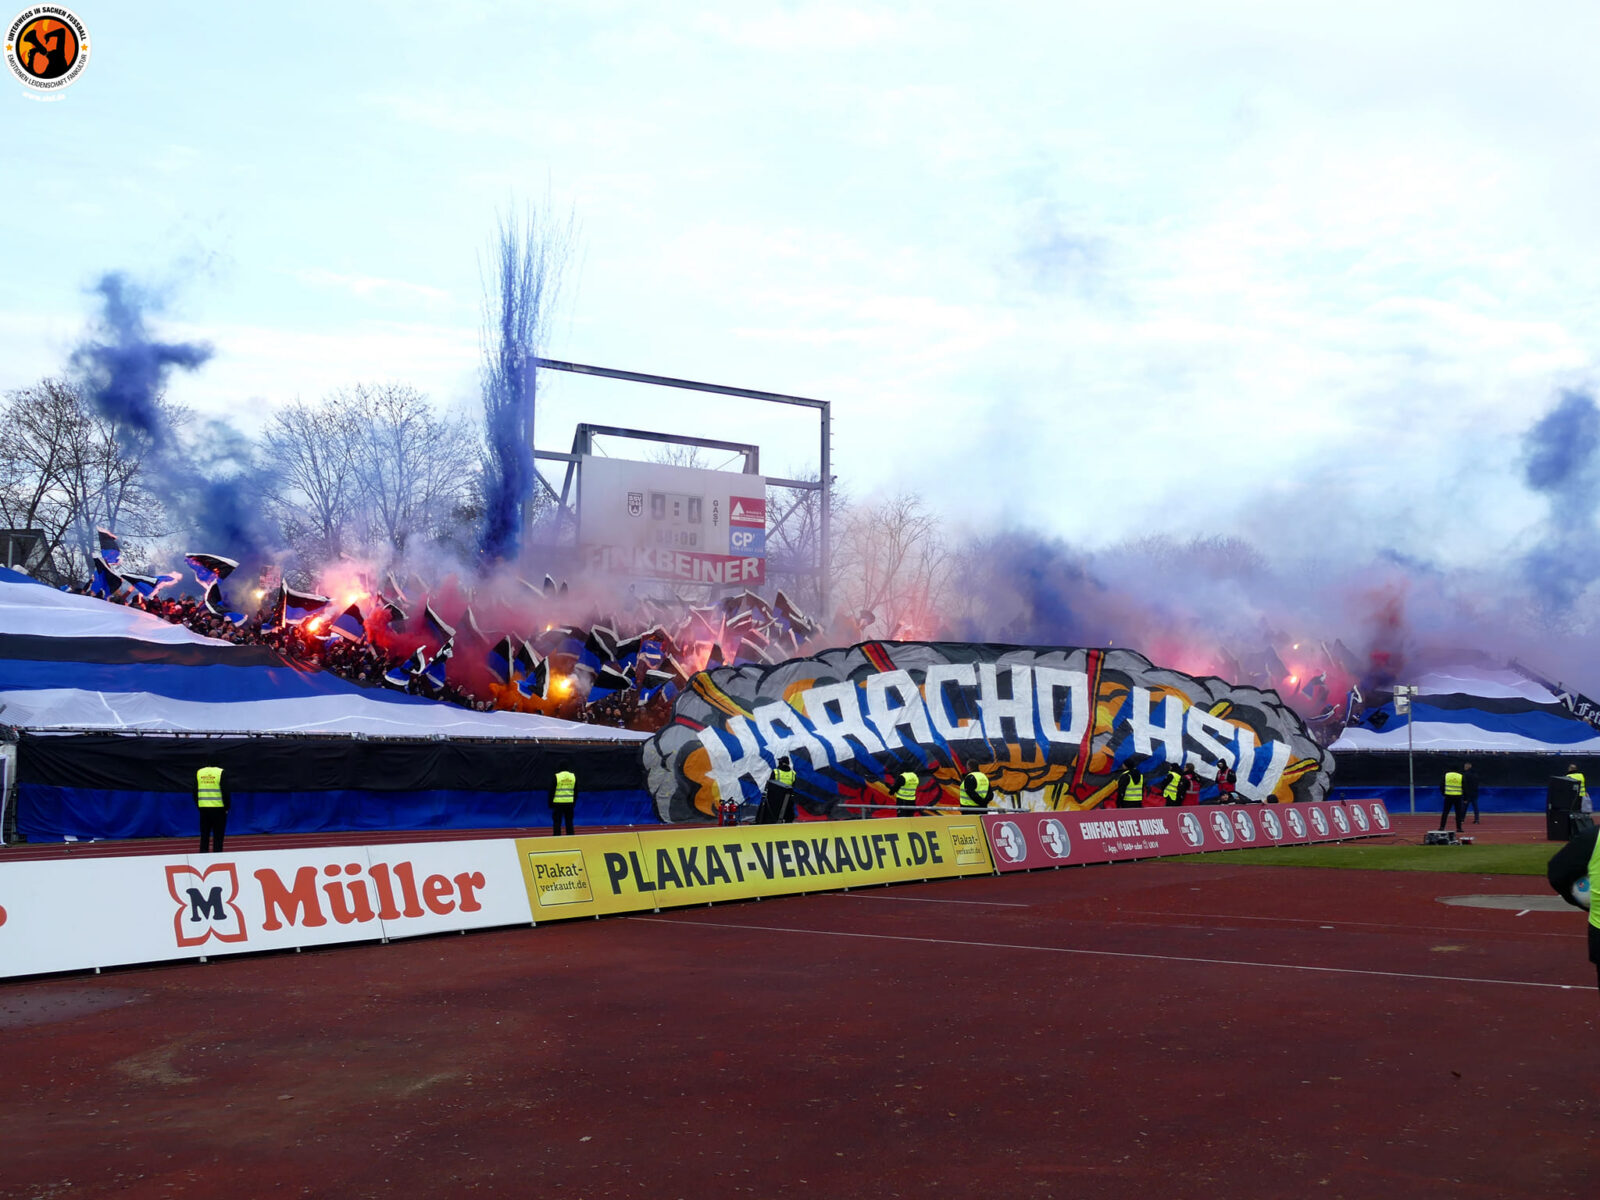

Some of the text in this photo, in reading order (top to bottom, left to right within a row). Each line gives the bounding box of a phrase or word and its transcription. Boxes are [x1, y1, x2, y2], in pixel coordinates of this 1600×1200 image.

[696, 662, 1291, 805] KARACHO HSV
[952, 834, 978, 846] Plakat-
[1000, 826, 1019, 858] 3
[1046, 824, 1063, 854] 3
[1080, 818, 1169, 840] EINFACH GUTE MUSIK.
[535, 863, 583, 879] Plakat-
[604, 830, 944, 894] PLAKAT-VERKAUFT.DE
[186, 861, 486, 931] M Müller
[540, 880, 587, 892] verkauft.de
